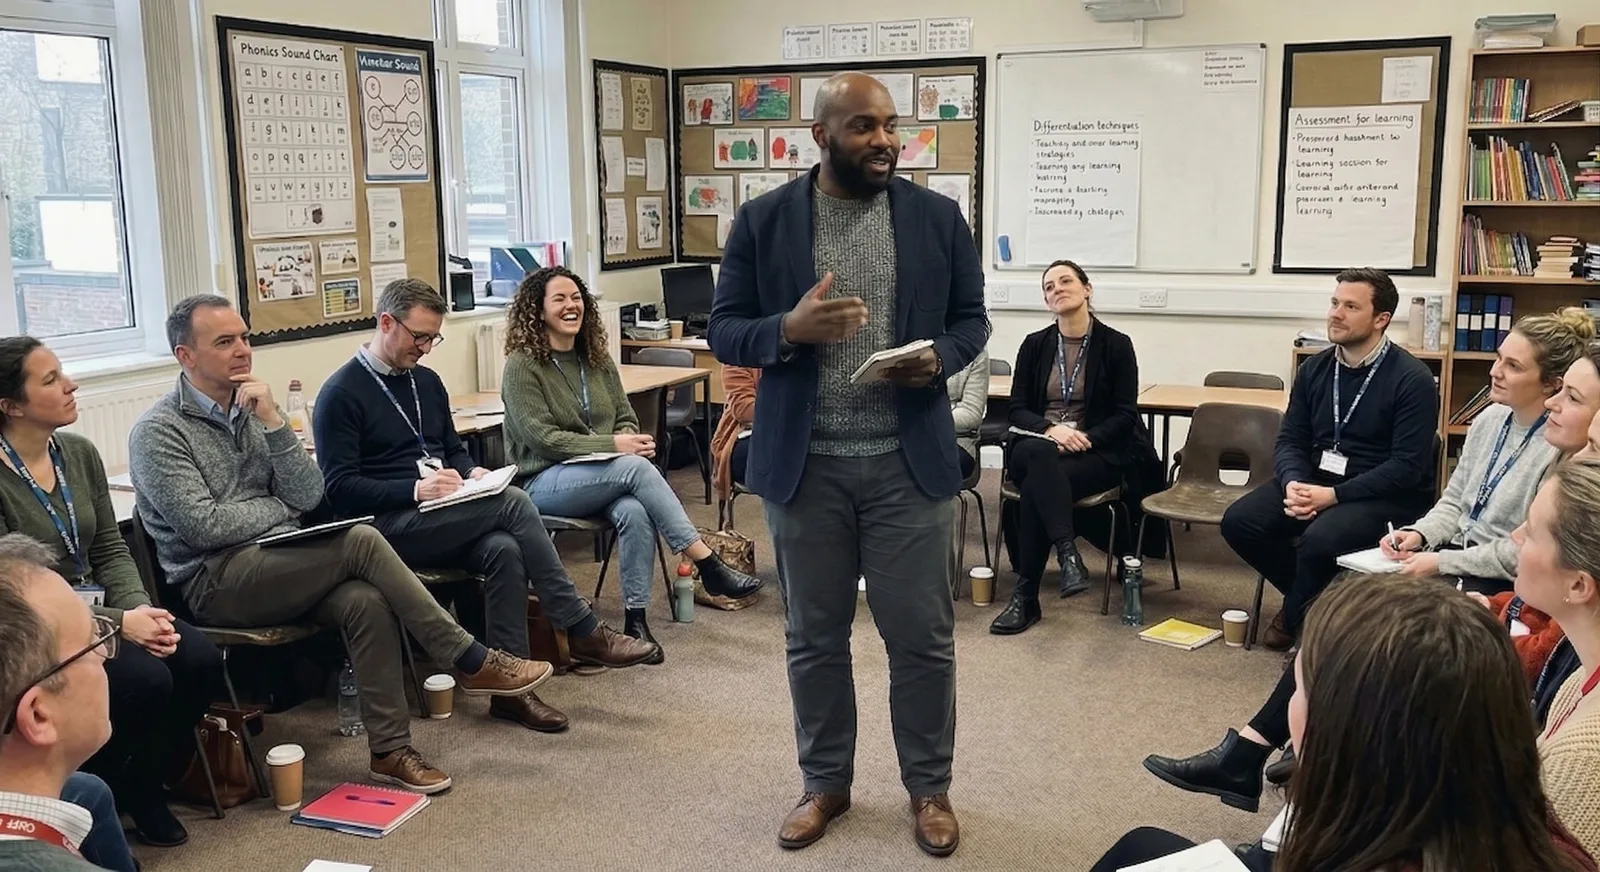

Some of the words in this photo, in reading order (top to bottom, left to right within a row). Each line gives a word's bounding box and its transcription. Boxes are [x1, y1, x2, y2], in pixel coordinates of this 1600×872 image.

[241, 43, 279, 57] Phonics
[282, 46, 311, 60] Sound
[313, 50, 338, 62] Chart
[245, 68, 252, 77] a
[261, 67, 267, 78] b
[277, 71, 282, 79] c
[306, 71, 312, 81] d
[247, 94, 254, 105] d
[264, 97, 270, 105] e
[280, 95, 284, 107] f
[1295, 113, 1351, 126] Assessment
[1356, 113, 1370, 126] for
[1375, 113, 1414, 129] learning
[266, 124, 272, 135] g
[282, 122, 288, 133] h
[311, 124, 316, 134] k
[253, 153, 259, 161] o
[268, 153, 275, 164] p
[284, 153, 290, 164] q
[1296, 160, 1334, 169] Learning
[1376, 158, 1389, 166] for
[1298, 170, 1333, 181] learning
[284, 183, 294, 191] w
[329, 182, 334, 192] y
